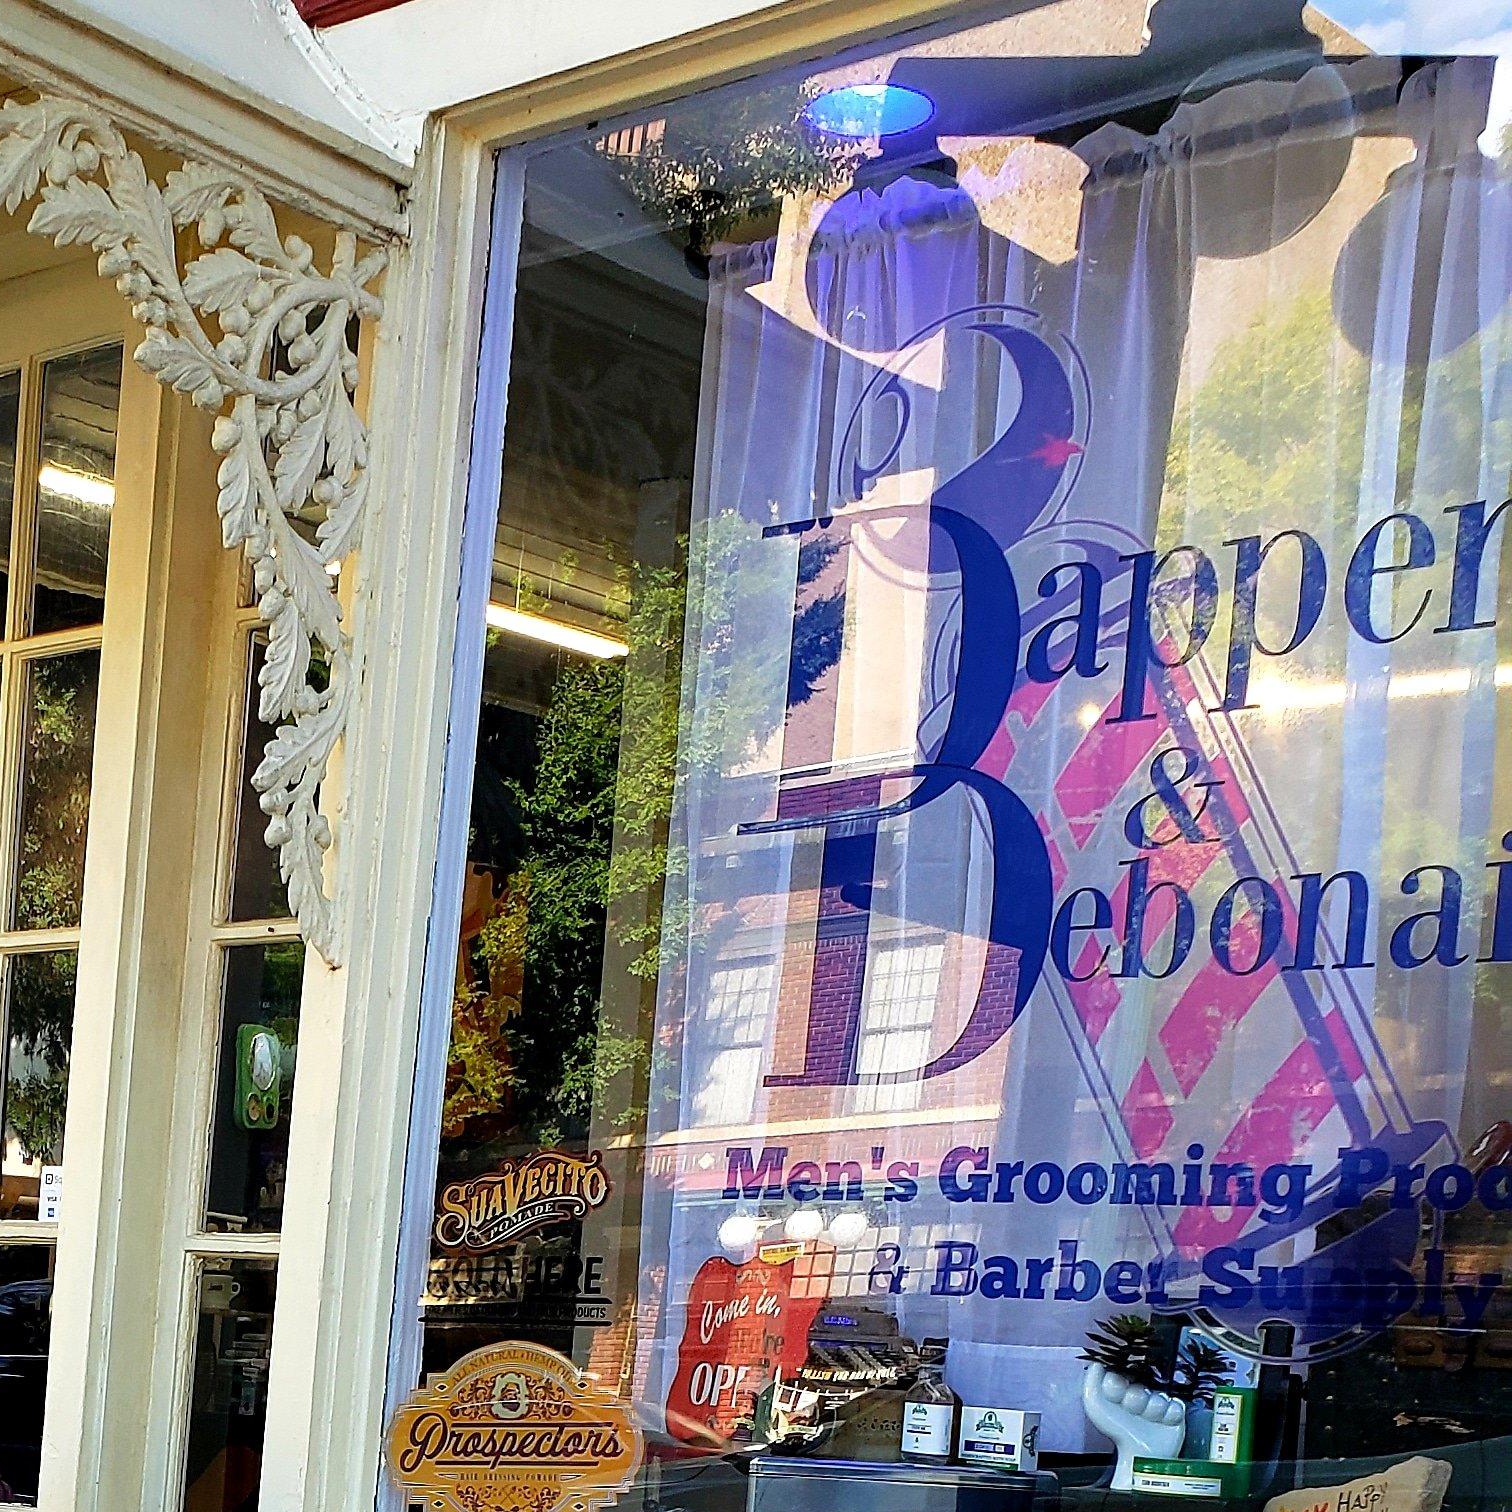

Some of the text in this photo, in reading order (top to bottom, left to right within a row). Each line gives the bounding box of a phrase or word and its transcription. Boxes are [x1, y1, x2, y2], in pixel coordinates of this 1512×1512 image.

[737, 498, 1512, 834] Dapper
[1125, 746, 1226, 850] &
[722, 1146, 918, 1201] Men's
[938, 1143, 1312, 1224] Grooming
[490, 1203, 554, 1238] POMADE
[521, 1256, 604, 1295] HERE
[868, 1238, 1502, 1337] & Barber Supply
[699, 1294, 750, 1345] Come
[469, 1349, 519, 1371] NATURAL
[400, 1412, 625, 1473] Prospectors
